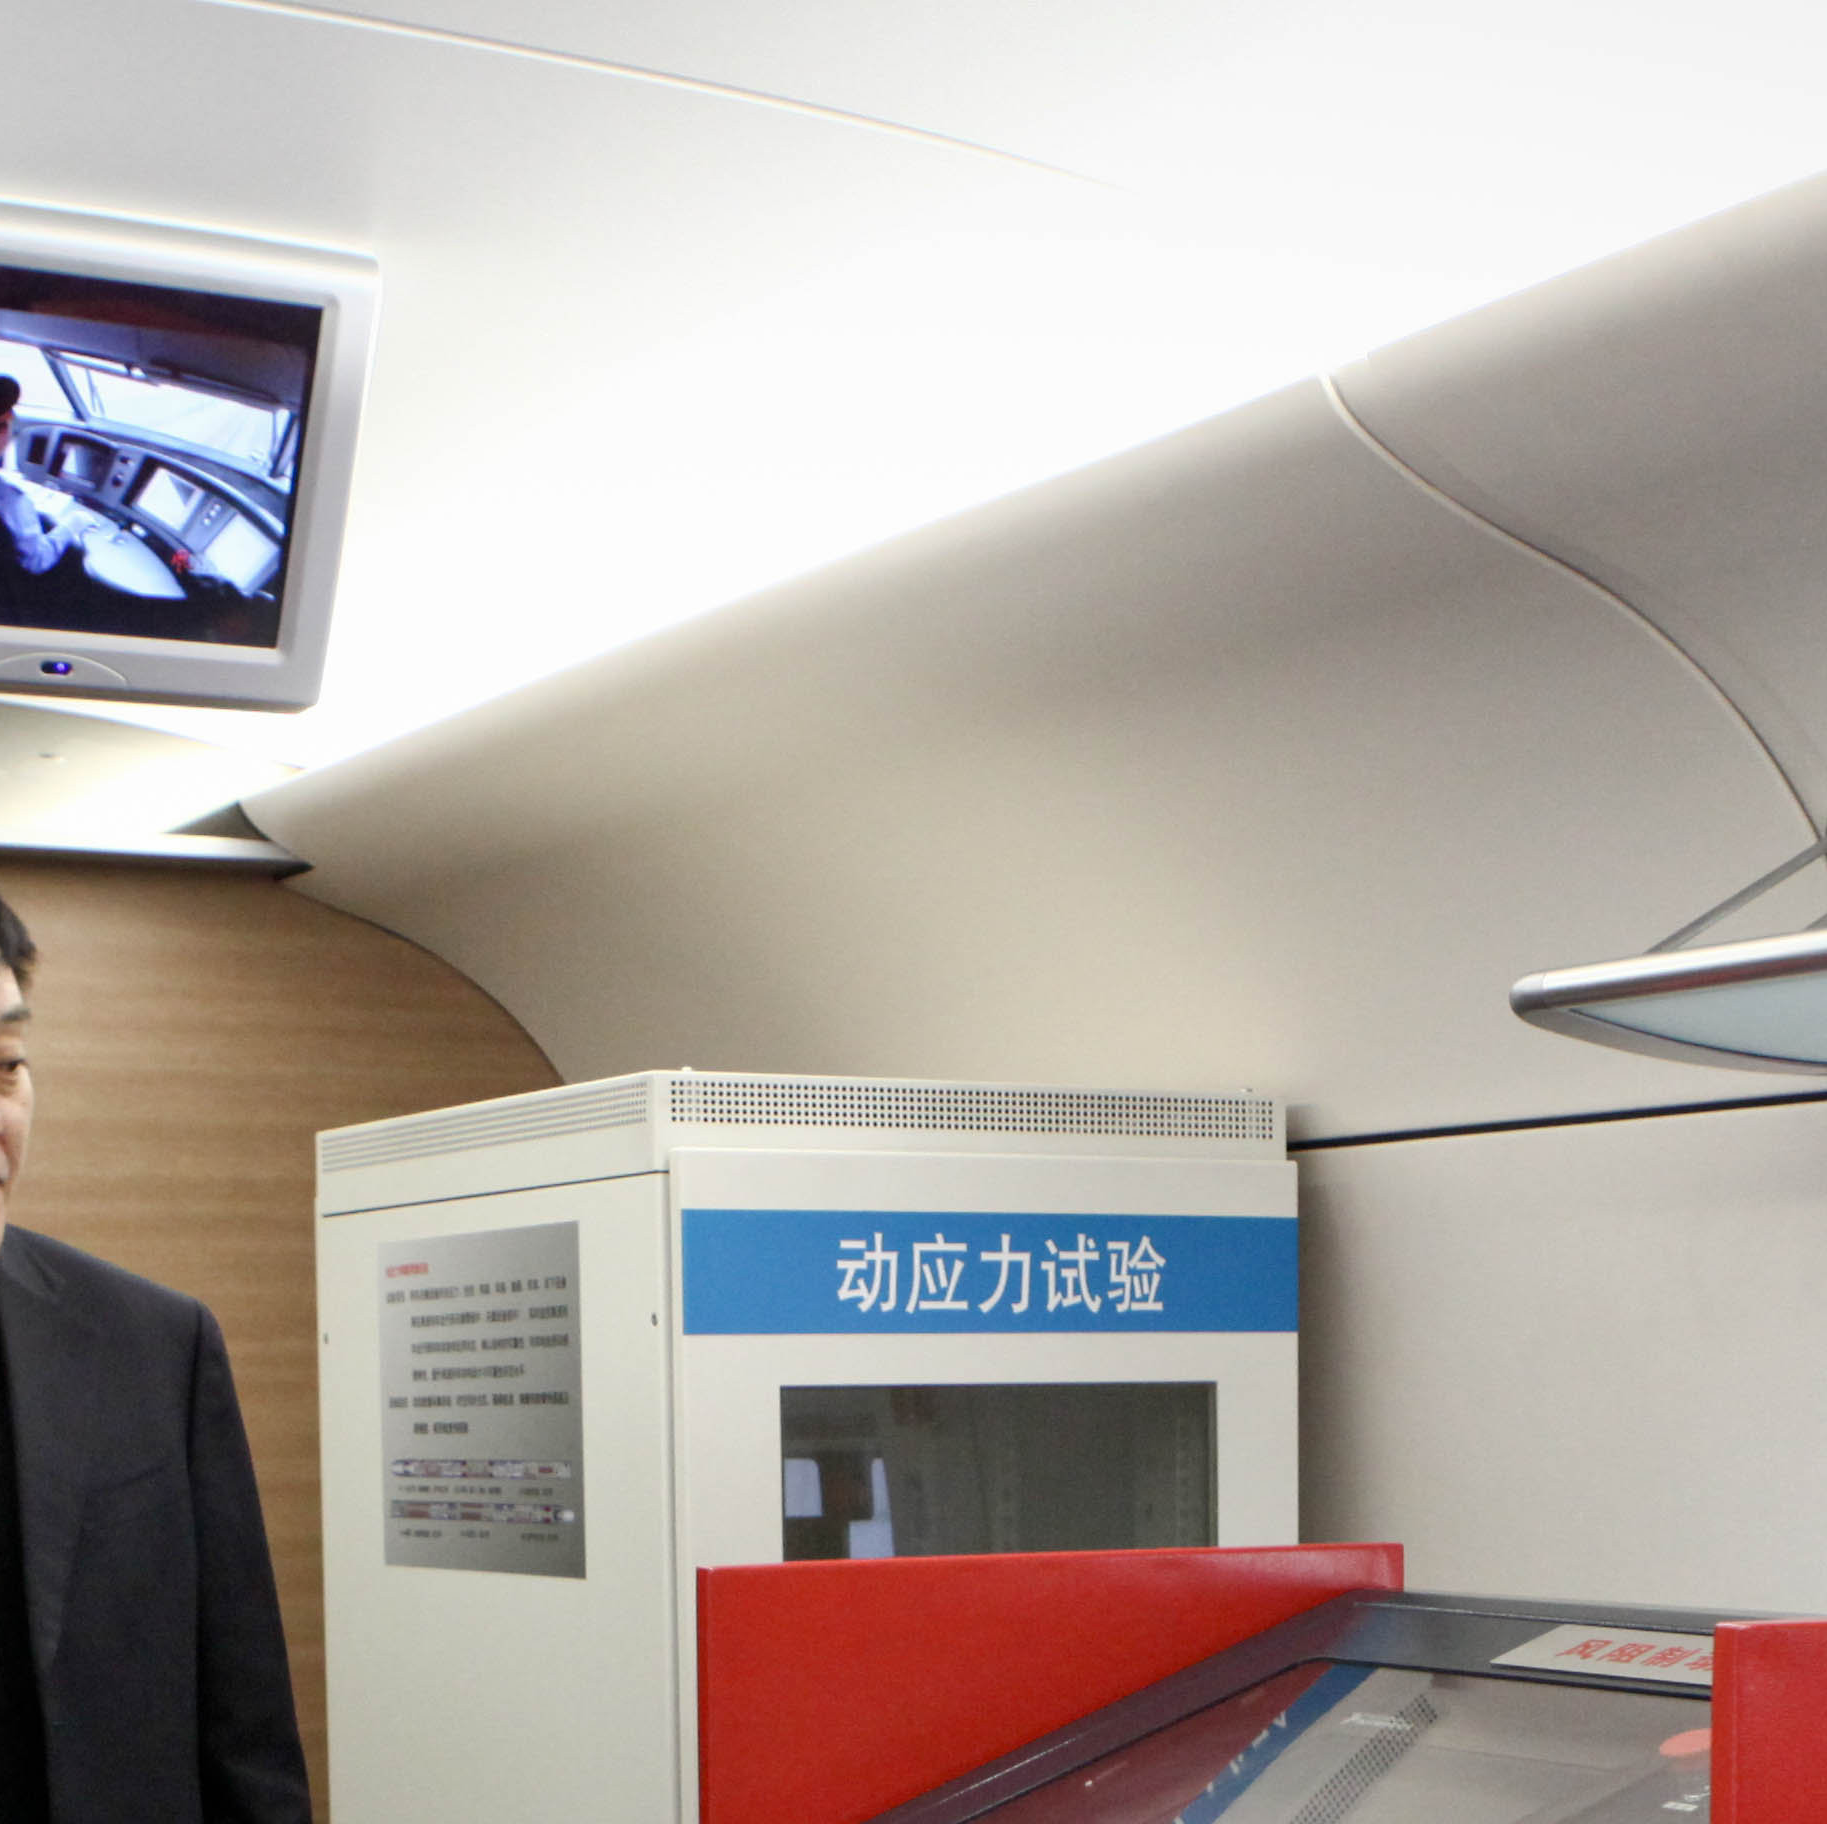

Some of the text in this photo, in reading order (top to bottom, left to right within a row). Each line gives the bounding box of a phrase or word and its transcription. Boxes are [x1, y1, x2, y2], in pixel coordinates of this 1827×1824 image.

[836, 1231, 1167, 1315] 动应力试验
